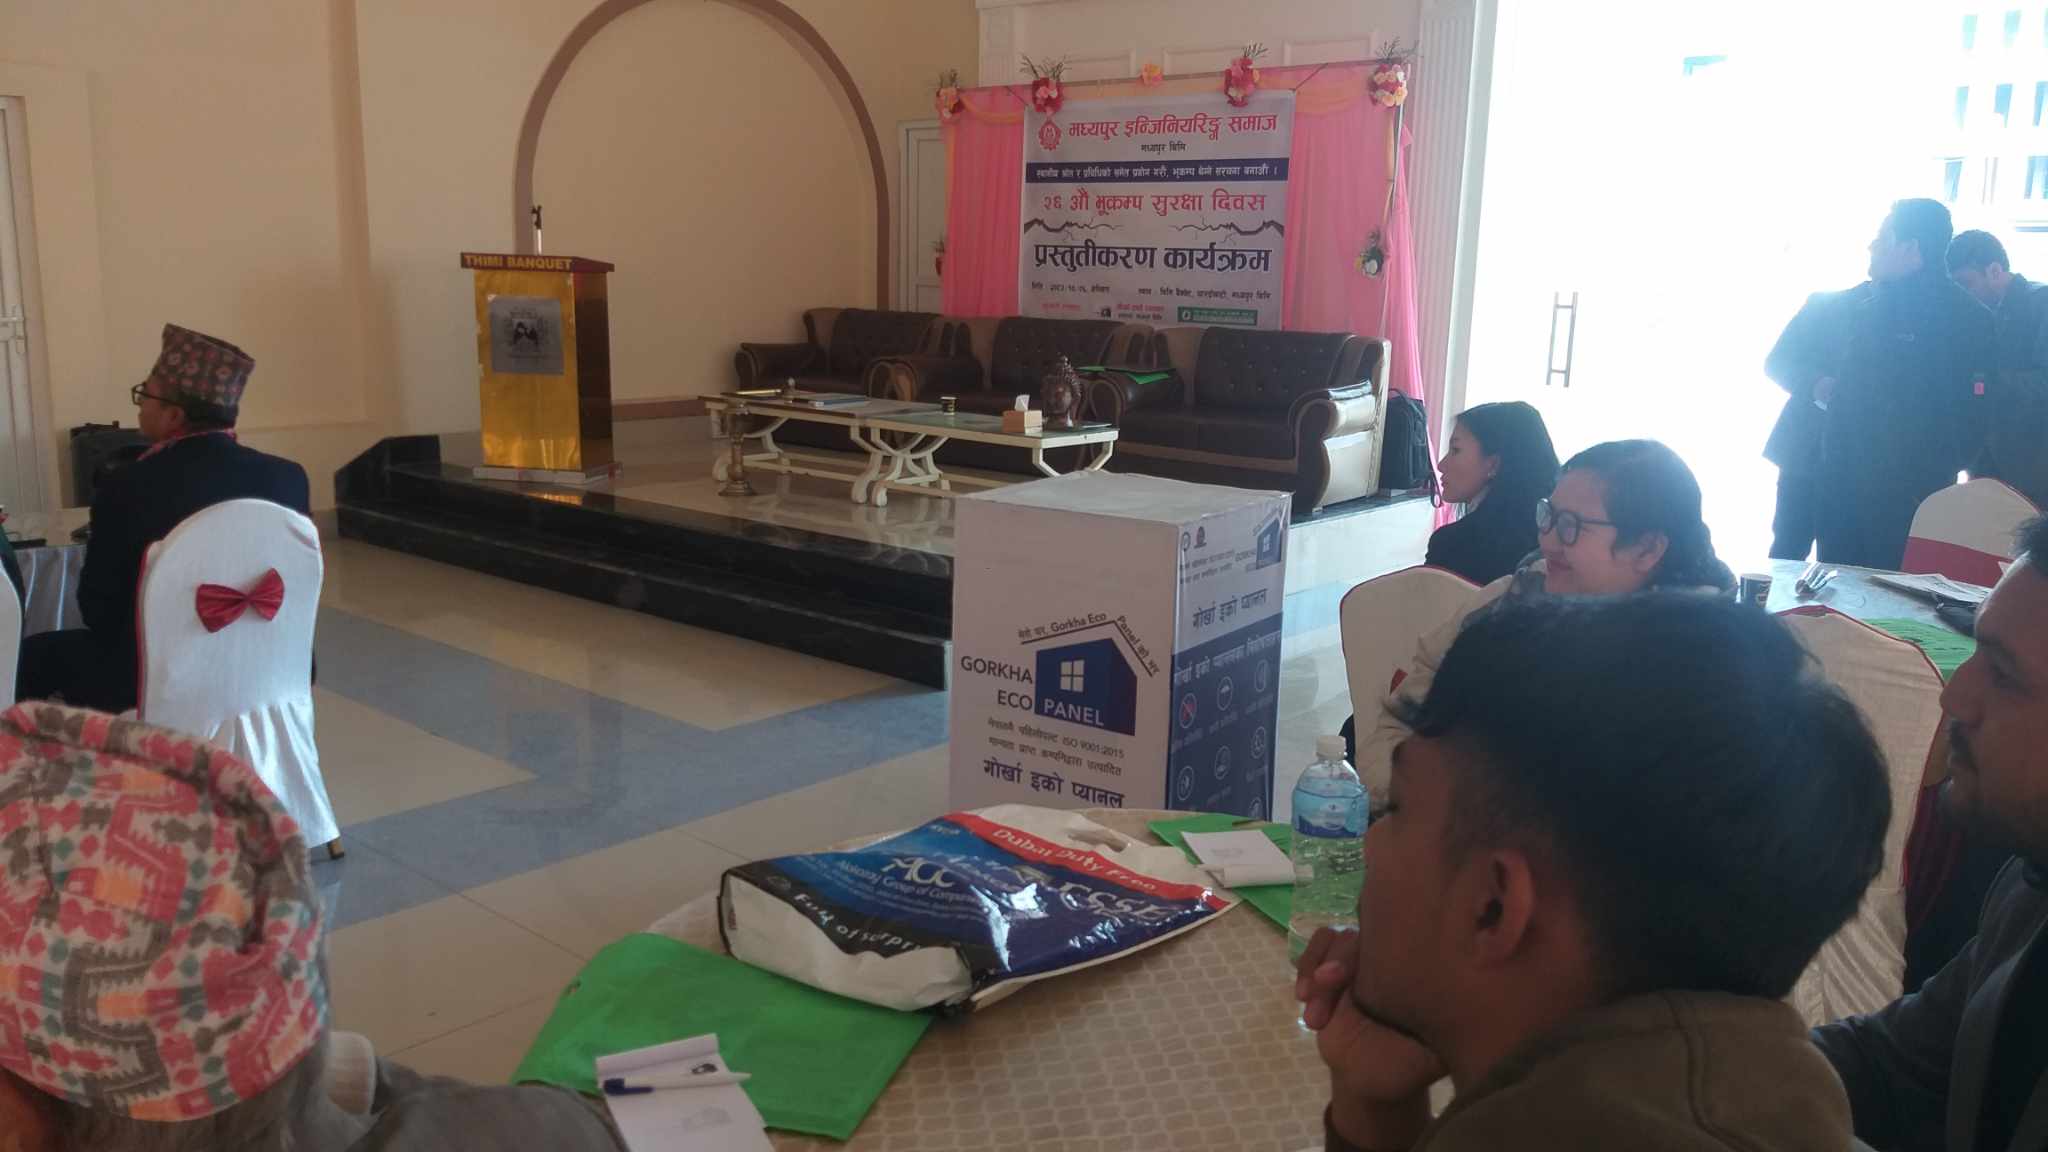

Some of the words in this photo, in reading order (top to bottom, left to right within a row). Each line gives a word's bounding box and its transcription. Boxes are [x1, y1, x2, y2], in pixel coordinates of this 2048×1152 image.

[1228, 114, 1277, 133] समाज
[1095, 194, 1144, 216] भूकम्प
[1152, 194, 1203, 216] सुरक्षा
[1212, 188, 1267, 211] दिवस
[507, 257, 572, 270] BANQUET
[1034, 239, 1157, 273] प्रस्तुतीकरण
[1163, 242, 1272, 272] कार्यक्रम
[1051, 618, 1087, 632] Gorkha
[1088, 613, 1107, 626] Eco
[1117, 615, 1141, 646] Panel
[961, 655, 1034, 685] GORKHA
[997, 689, 1033, 711] ECO
[1043, 698, 1105, 727] PANEL
[1030, 772, 1065, 795] इको
[1072, 781, 1125, 809] प्यानल
[992, 829, 1052, 857] Dubai
[1058, 849, 1104, 872] Duty
[1106, 869, 1157, 891] Free
